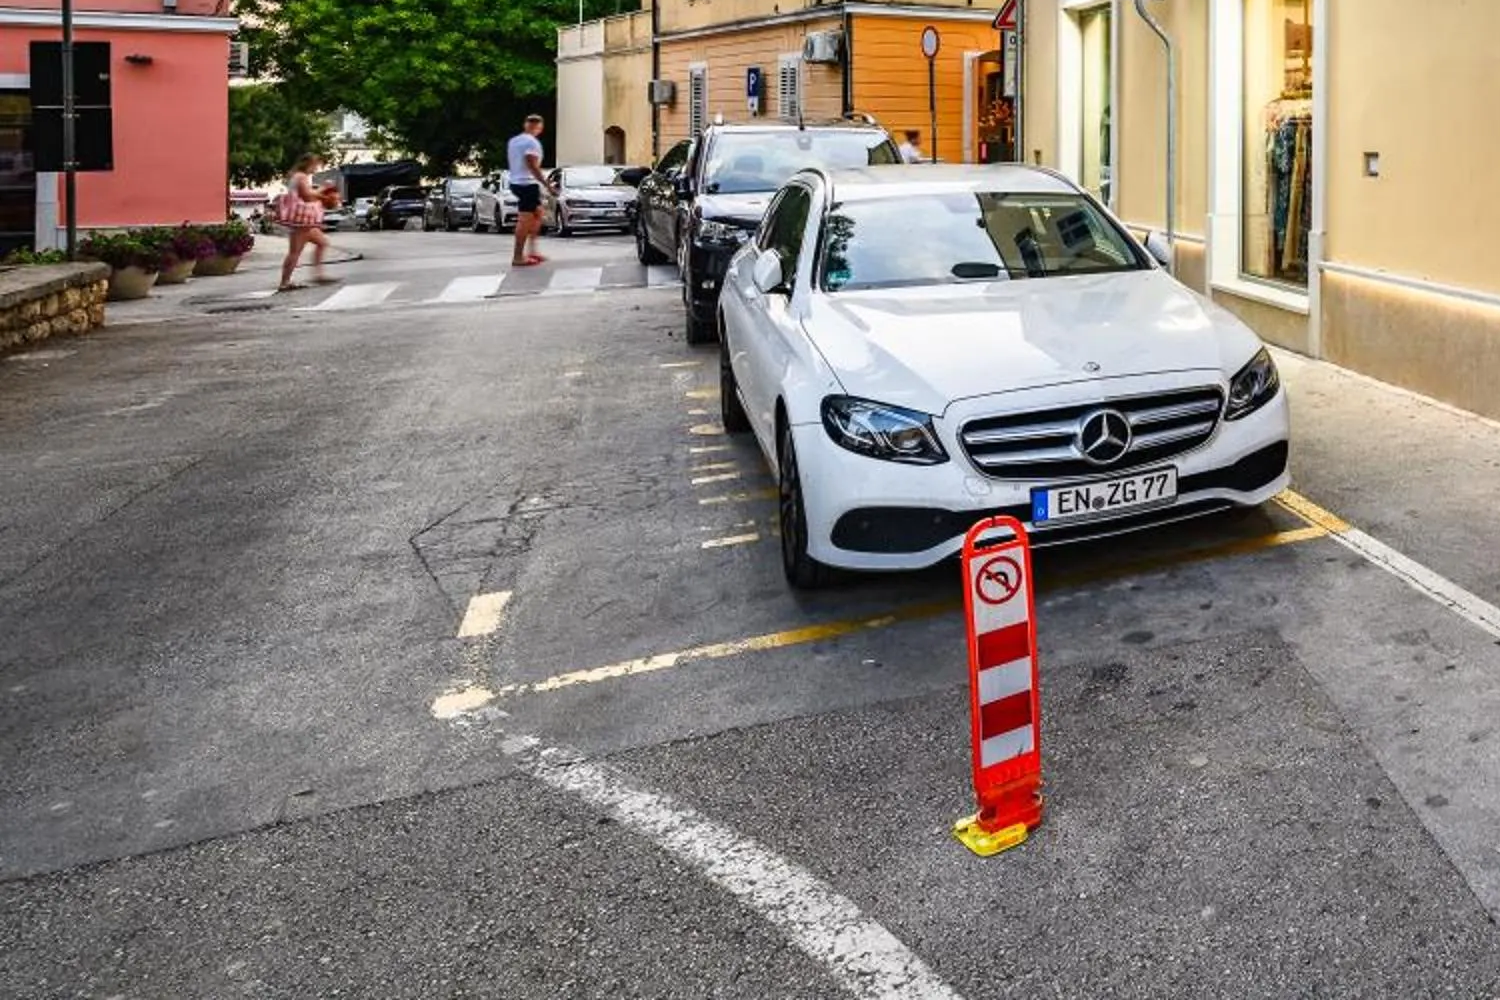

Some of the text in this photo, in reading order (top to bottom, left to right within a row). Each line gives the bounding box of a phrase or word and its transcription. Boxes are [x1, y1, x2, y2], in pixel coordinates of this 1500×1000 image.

[1058, 488, 1090, 514] EN
[1107, 480, 1137, 506] ZG
[1143, 474, 1168, 498] 77
